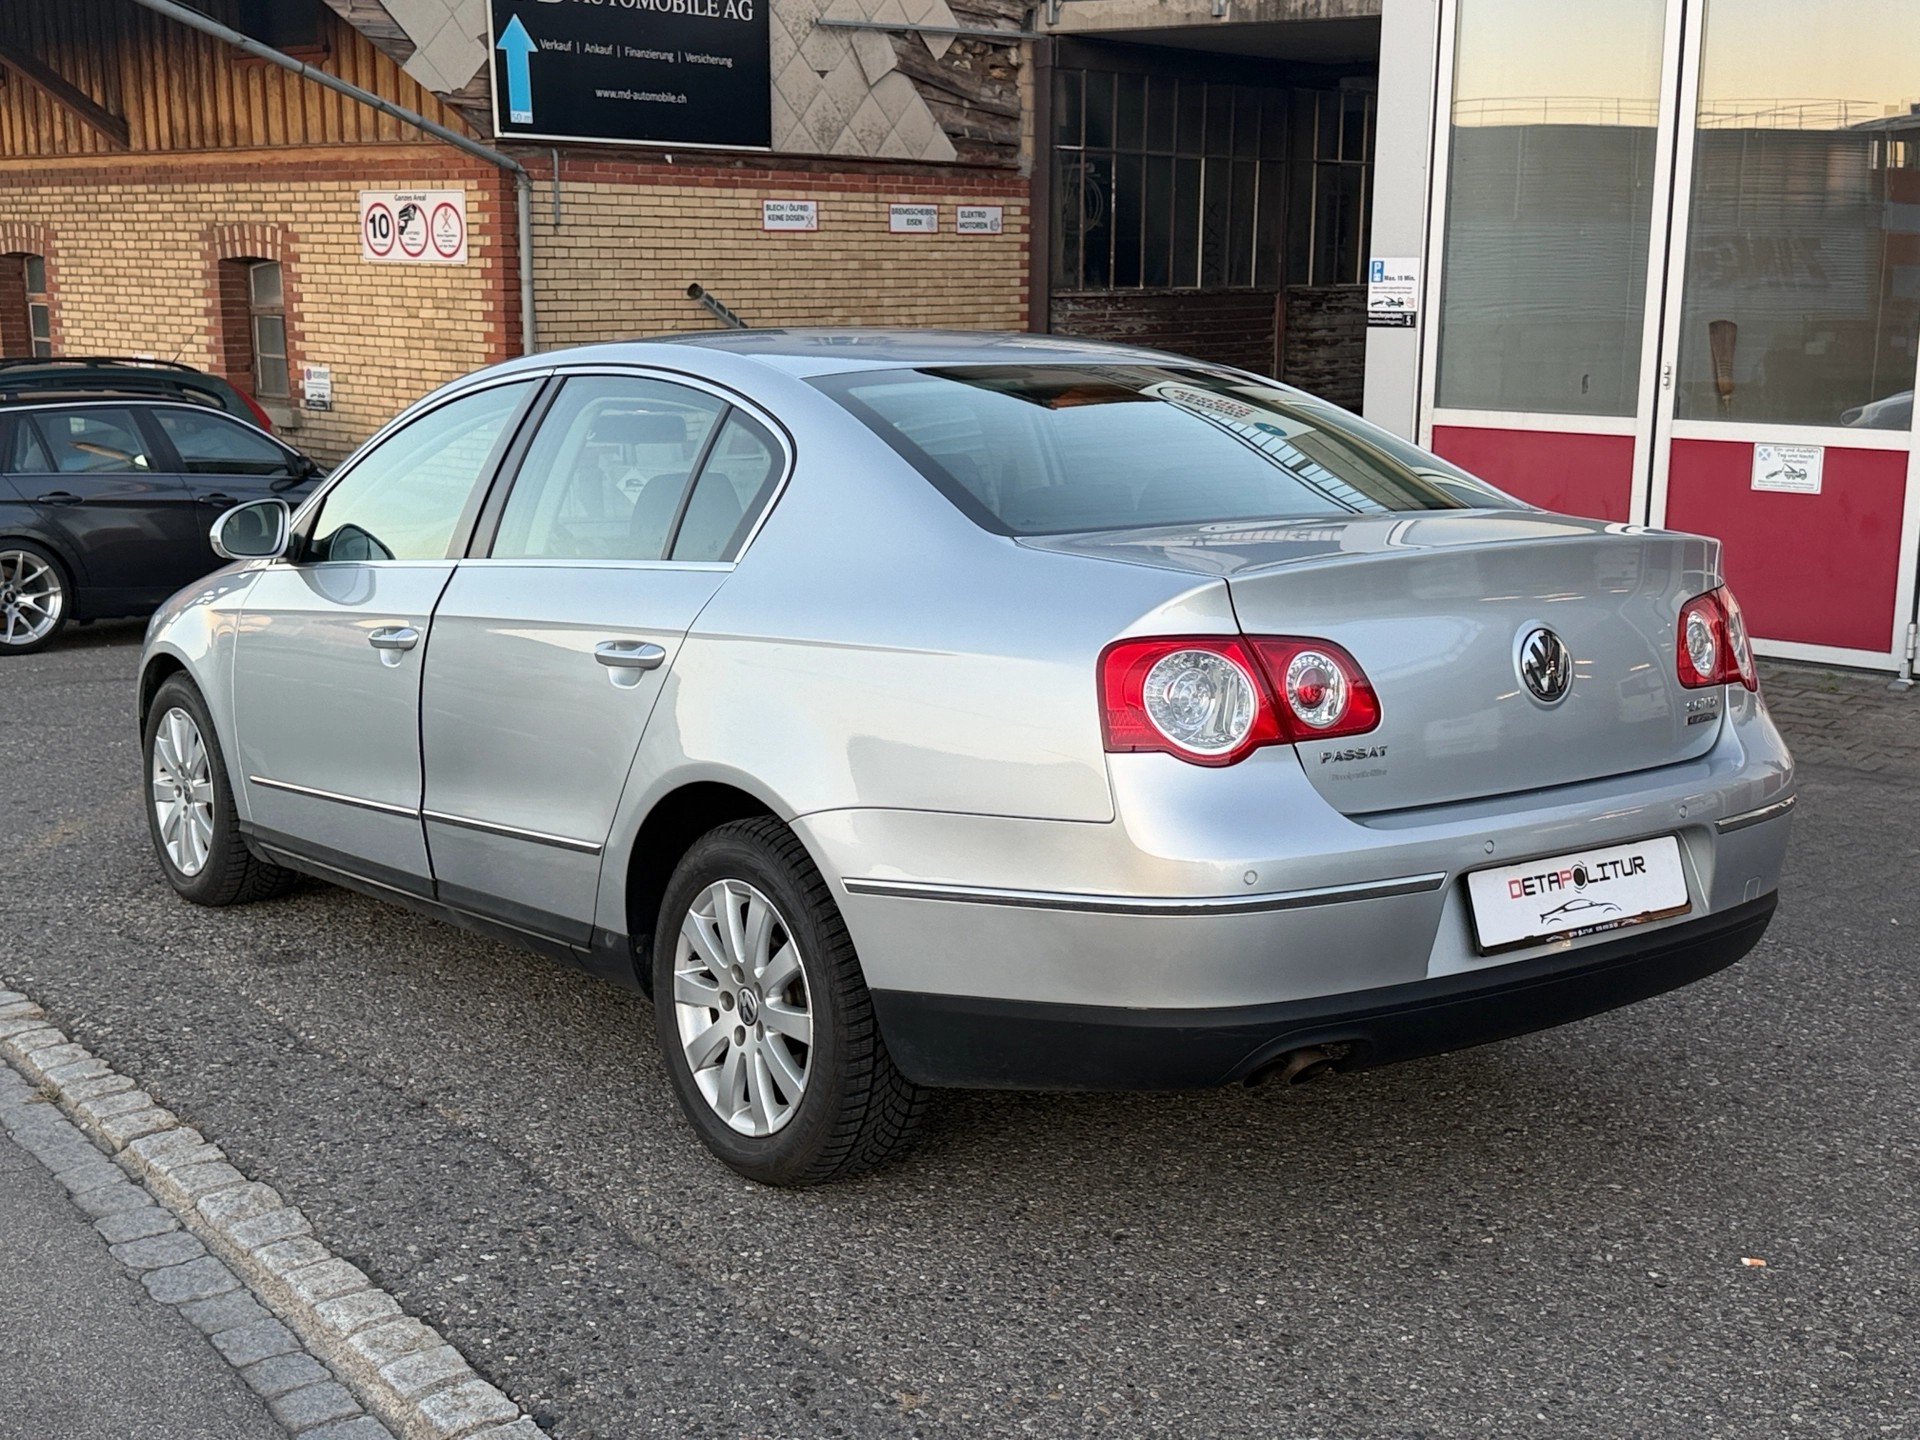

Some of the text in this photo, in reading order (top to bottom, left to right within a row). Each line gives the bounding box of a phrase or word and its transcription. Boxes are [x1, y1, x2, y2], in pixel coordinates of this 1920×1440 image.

[573, 0, 753, 21] MOBILE AG
[540, 39, 572, 52] Verkauf
[584, 43, 613, 55] Ankauf
[624, 46, 674, 63] Finanzierung
[684, 52, 733, 68] Versicherung
[595, 89, 687, 104] www.md-automobile.ch
[766, 203, 784, 212] BLECH
[960, 210, 987, 219] ELEKTRO
[768, 213, 805, 222] KEINE DOSEN
[906, 218, 922, 226] EISEN
[369, 213, 390, 239] 10
[959, 221, 988, 230] MOTOREN
[1320, 745, 1388, 764] PASSAT
[1508, 855, 1646, 899] DETAPOLITUR
